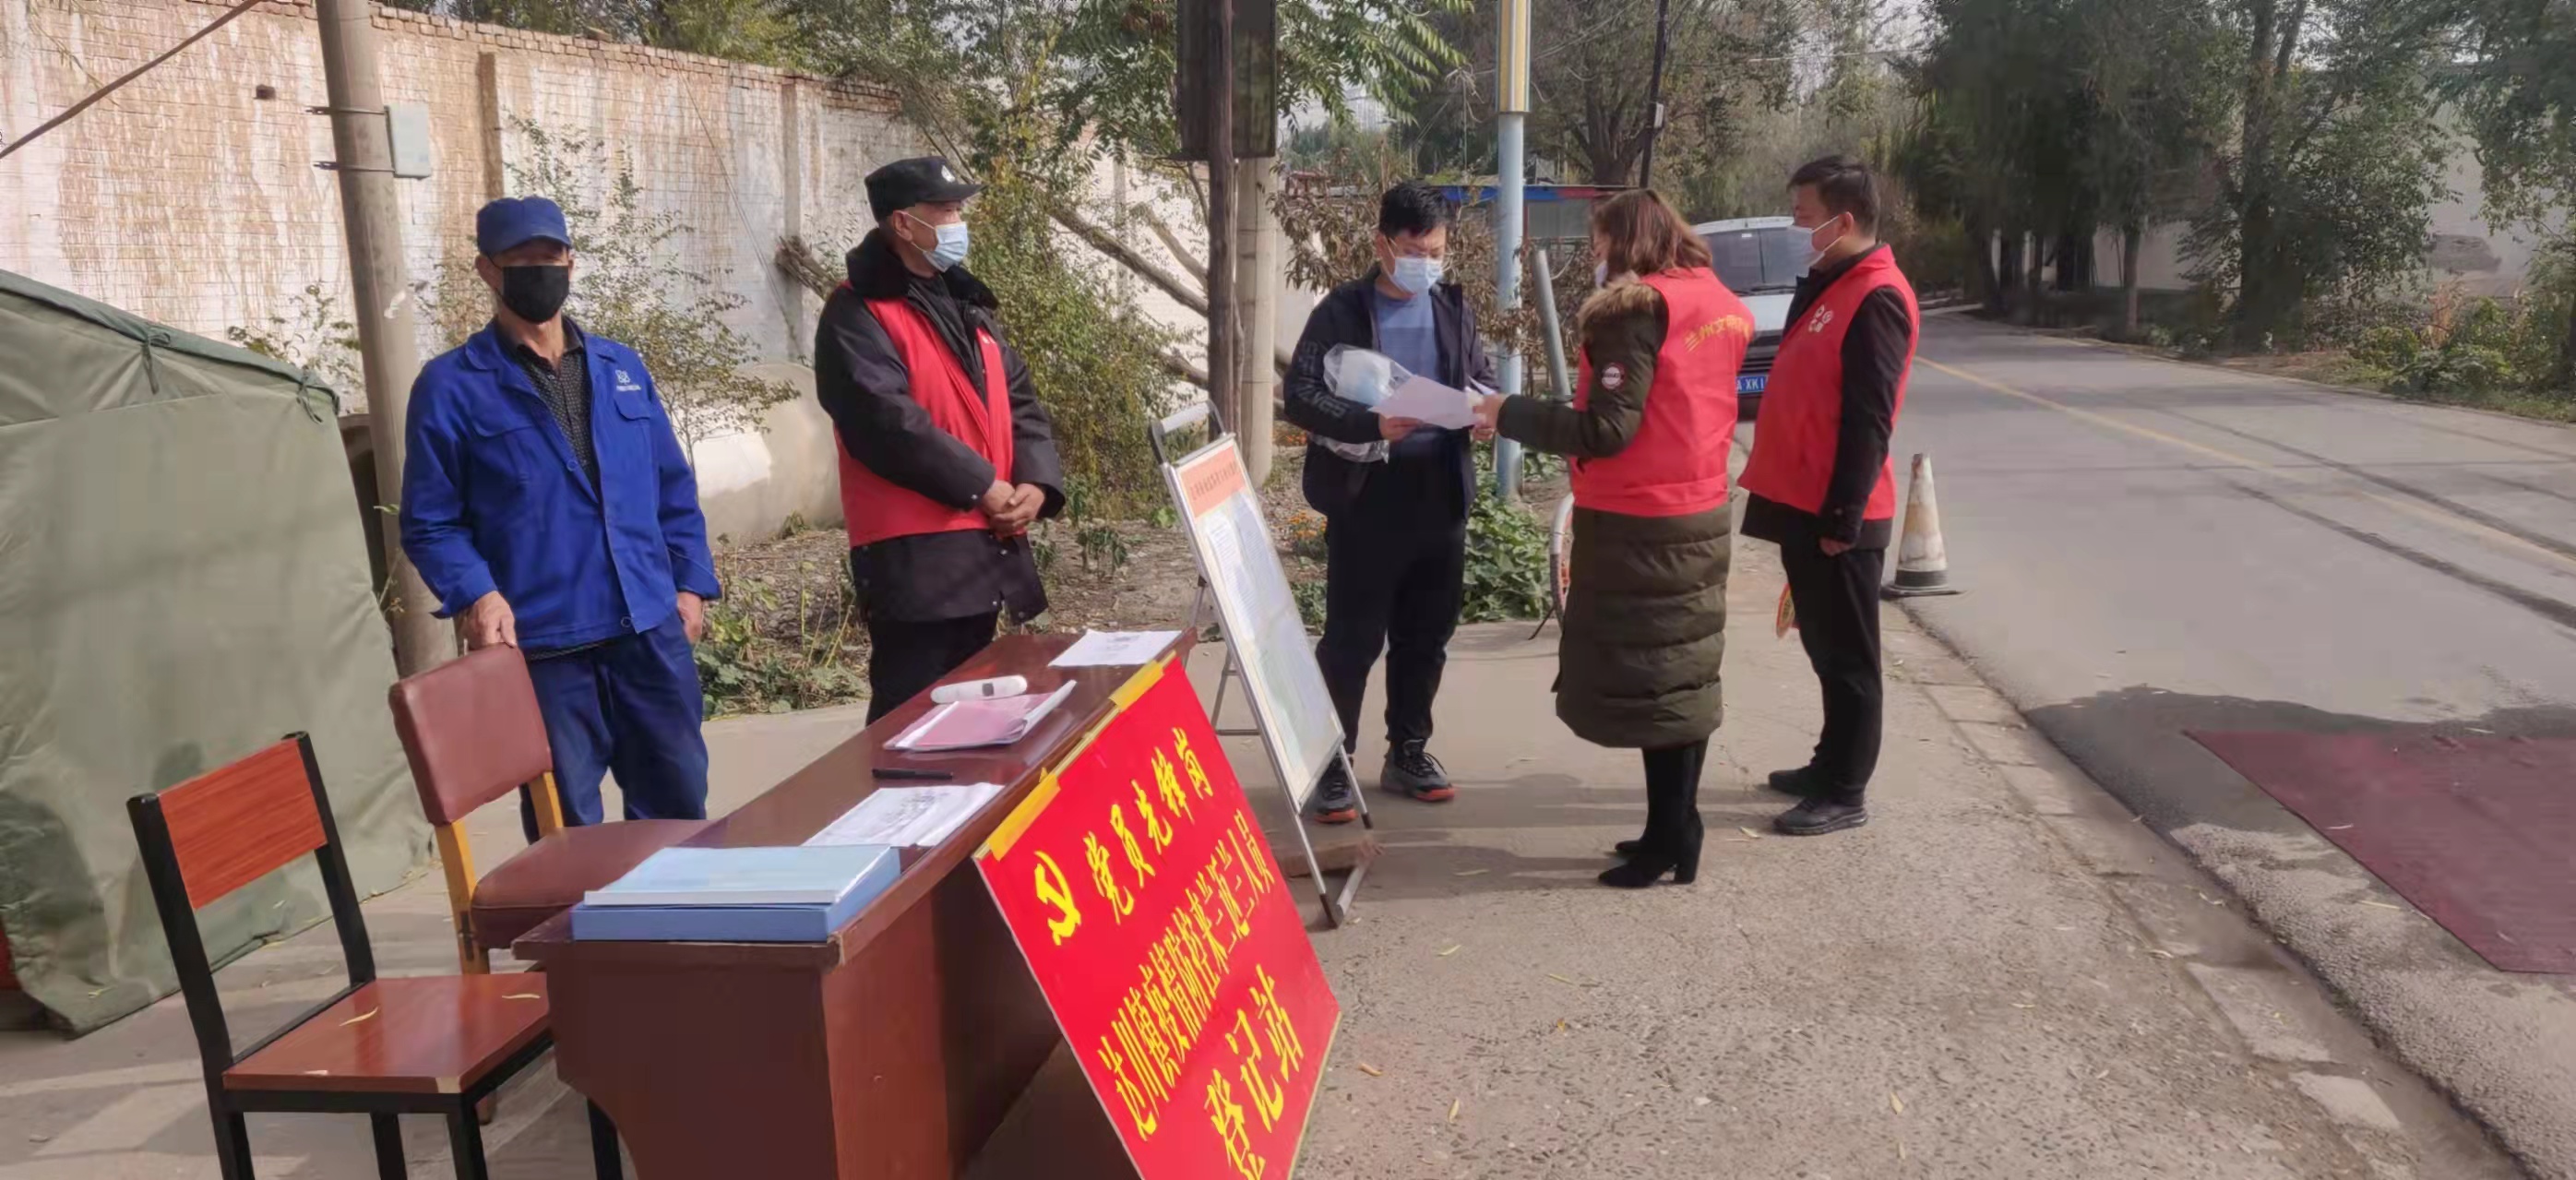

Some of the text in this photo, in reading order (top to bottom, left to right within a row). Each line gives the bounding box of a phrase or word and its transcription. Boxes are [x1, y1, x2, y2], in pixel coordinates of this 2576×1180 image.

[1085, 727, 1213, 924] 党员先锋岗
[1097, 808, 1275, 1141] 达川镇疫情防控来兰返兰人员
[1204, 963, 1305, 1180] 登记站
